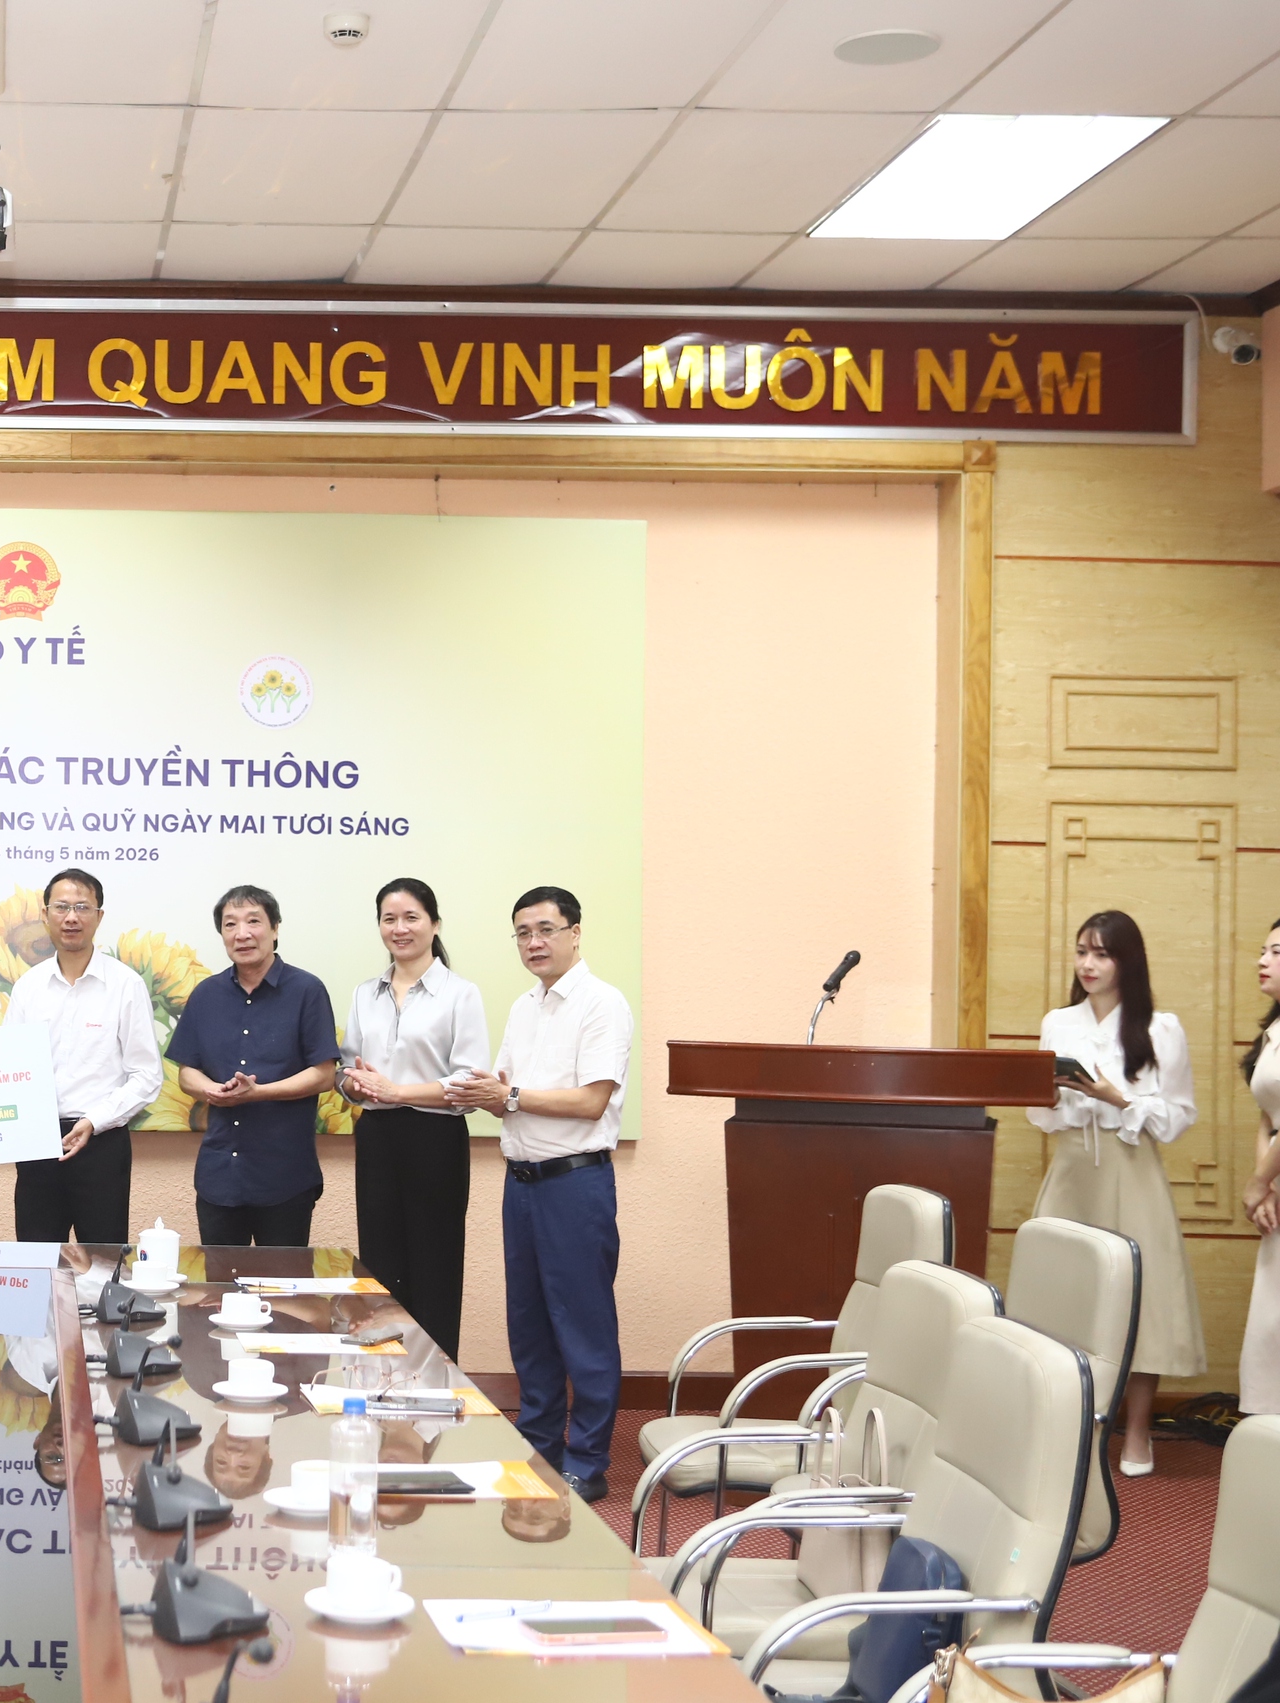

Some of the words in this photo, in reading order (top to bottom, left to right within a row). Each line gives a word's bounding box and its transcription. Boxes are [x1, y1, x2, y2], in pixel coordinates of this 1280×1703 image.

[87, 337, 387, 407] QUANG
[419, 341, 612, 409] VINH
[641, 328, 885, 413] MUÔN
[917, 332, 1102, 415] NĂM
[14, 637, 37, 664] Y
[46, 625, 85, 665] TẾ
[56, 745, 209, 786] TRUYỀN
[222, 752, 359, 789] THÔNG
[42, 807, 75, 831] VÀ
[83, 808, 136, 832] QUỸ
[144, 809, 212, 833] NGÀY
[220, 815, 264, 833] MAI
[273, 814, 331, 834] TƯƠI
[340, 811, 409, 836] SÁNG
[6, 846, 54, 863] tháng
[60, 847, 69, 859] 5
[75, 847, 109, 860] năm
[115, 848, 159, 861] 2026
[13, 1072, 31, 1082] OPC
